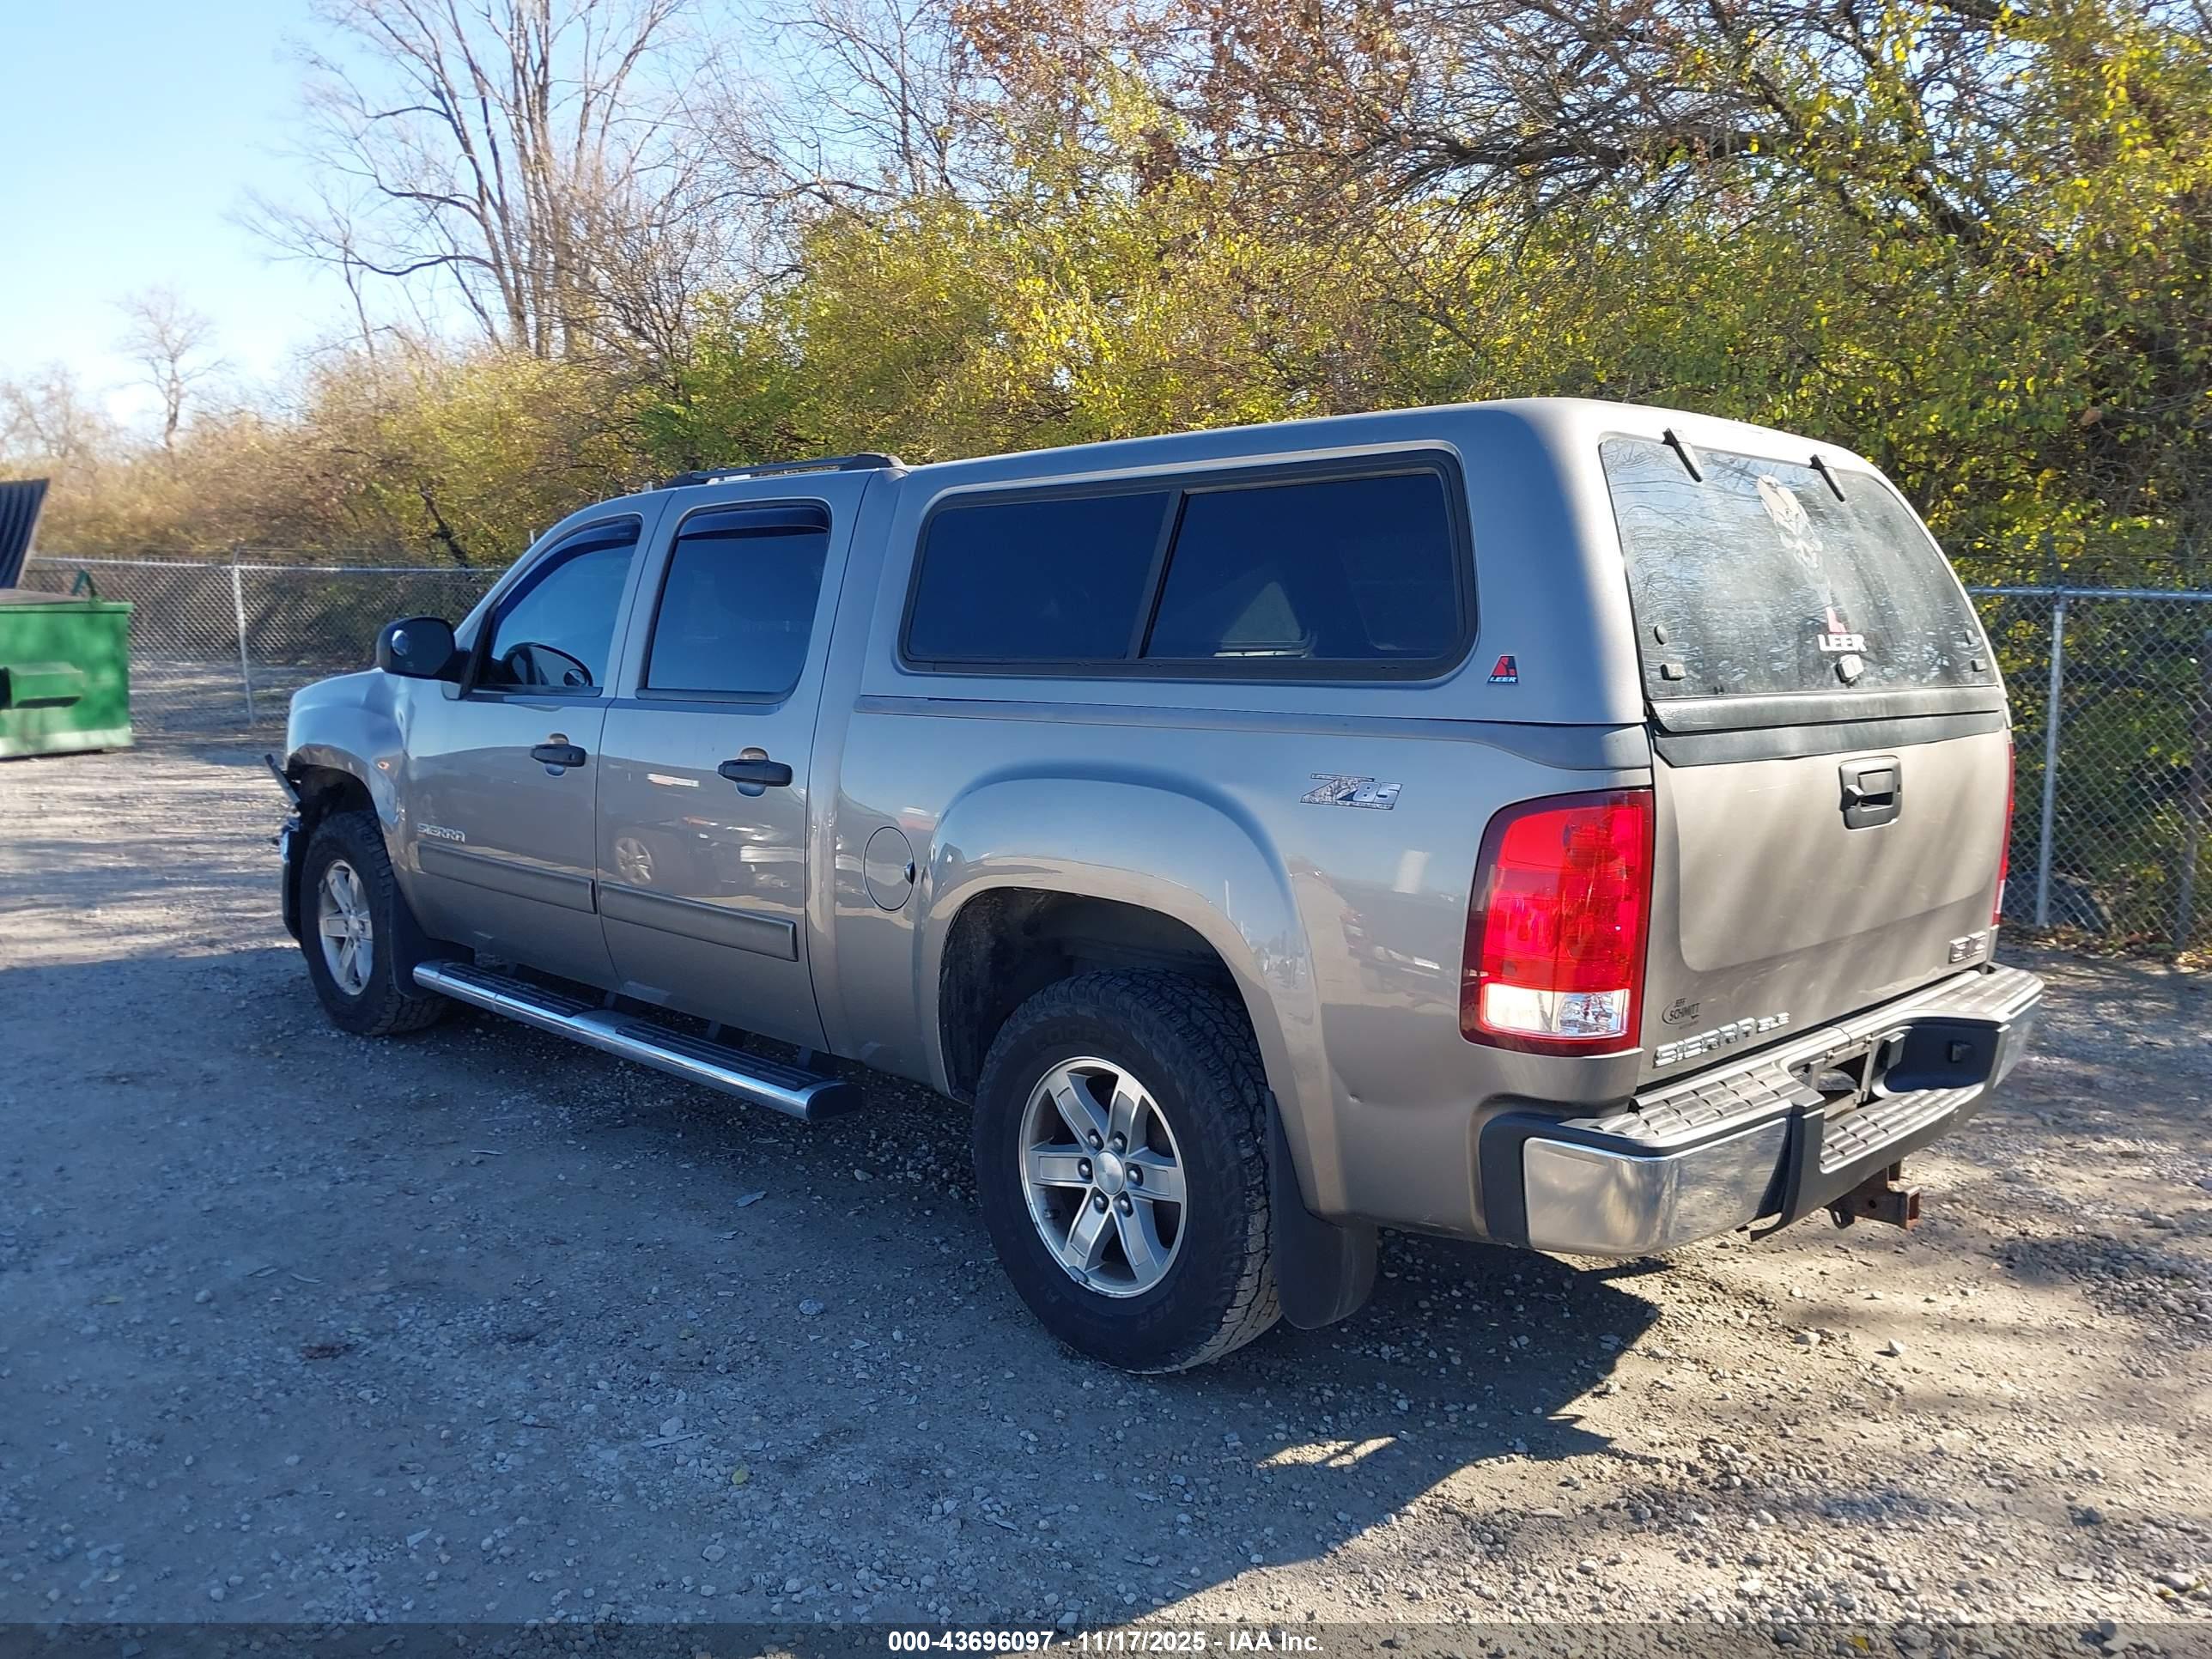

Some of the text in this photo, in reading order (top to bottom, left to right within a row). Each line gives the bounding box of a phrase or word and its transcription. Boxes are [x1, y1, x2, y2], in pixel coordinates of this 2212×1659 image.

[1817, 634, 1868, 653] LEER
[417, 823, 465, 842] SIERRA
[1668, 1003, 1700, 1022] SCHMITT
